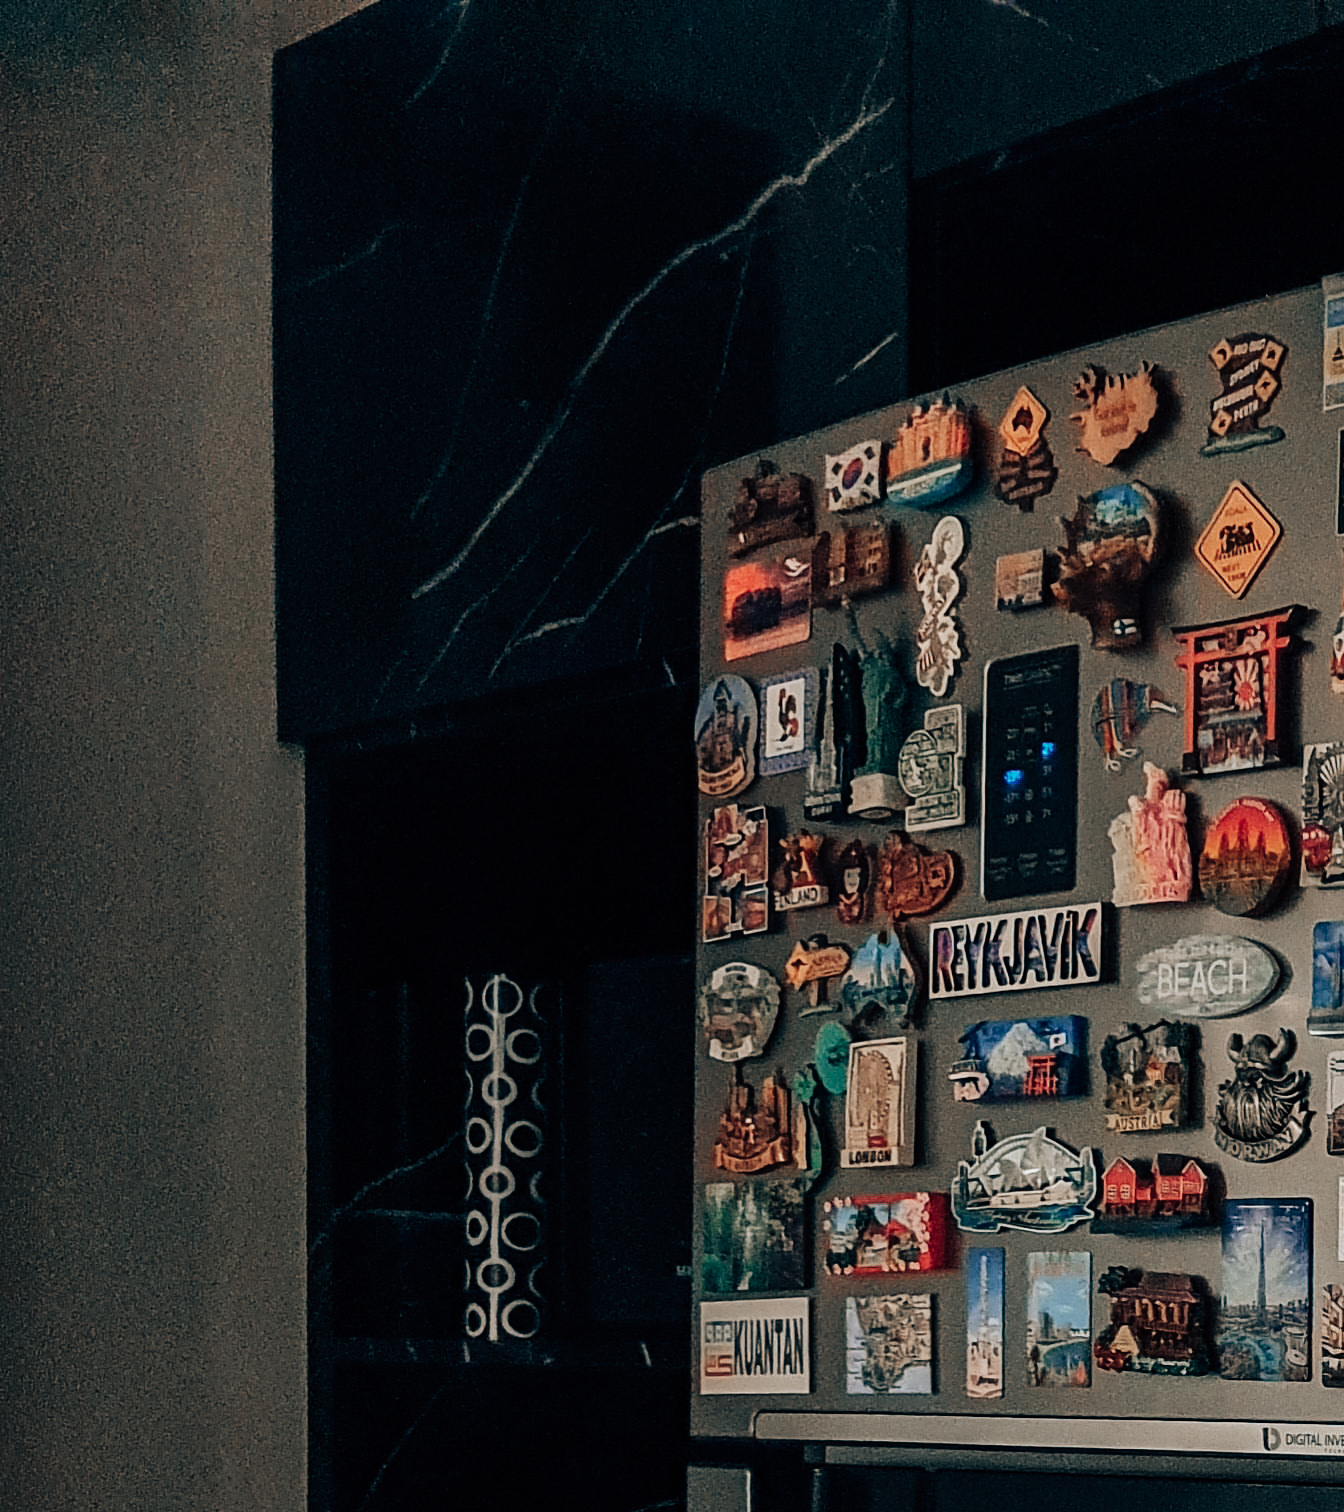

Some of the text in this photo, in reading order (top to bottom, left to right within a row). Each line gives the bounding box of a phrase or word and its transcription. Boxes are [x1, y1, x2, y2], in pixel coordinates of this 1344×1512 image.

[932, 908, 1098, 994] REYKJAVIK
[1157, 959, 1247, 999] BEACH
[1114, 1112, 1162, 1130] AUSTRIA
[848, 1150, 892, 1165] LONDON
[733, 1318, 804, 1376] KUANTAN
[1285, 1433, 1322, 1447] DIGITAL
